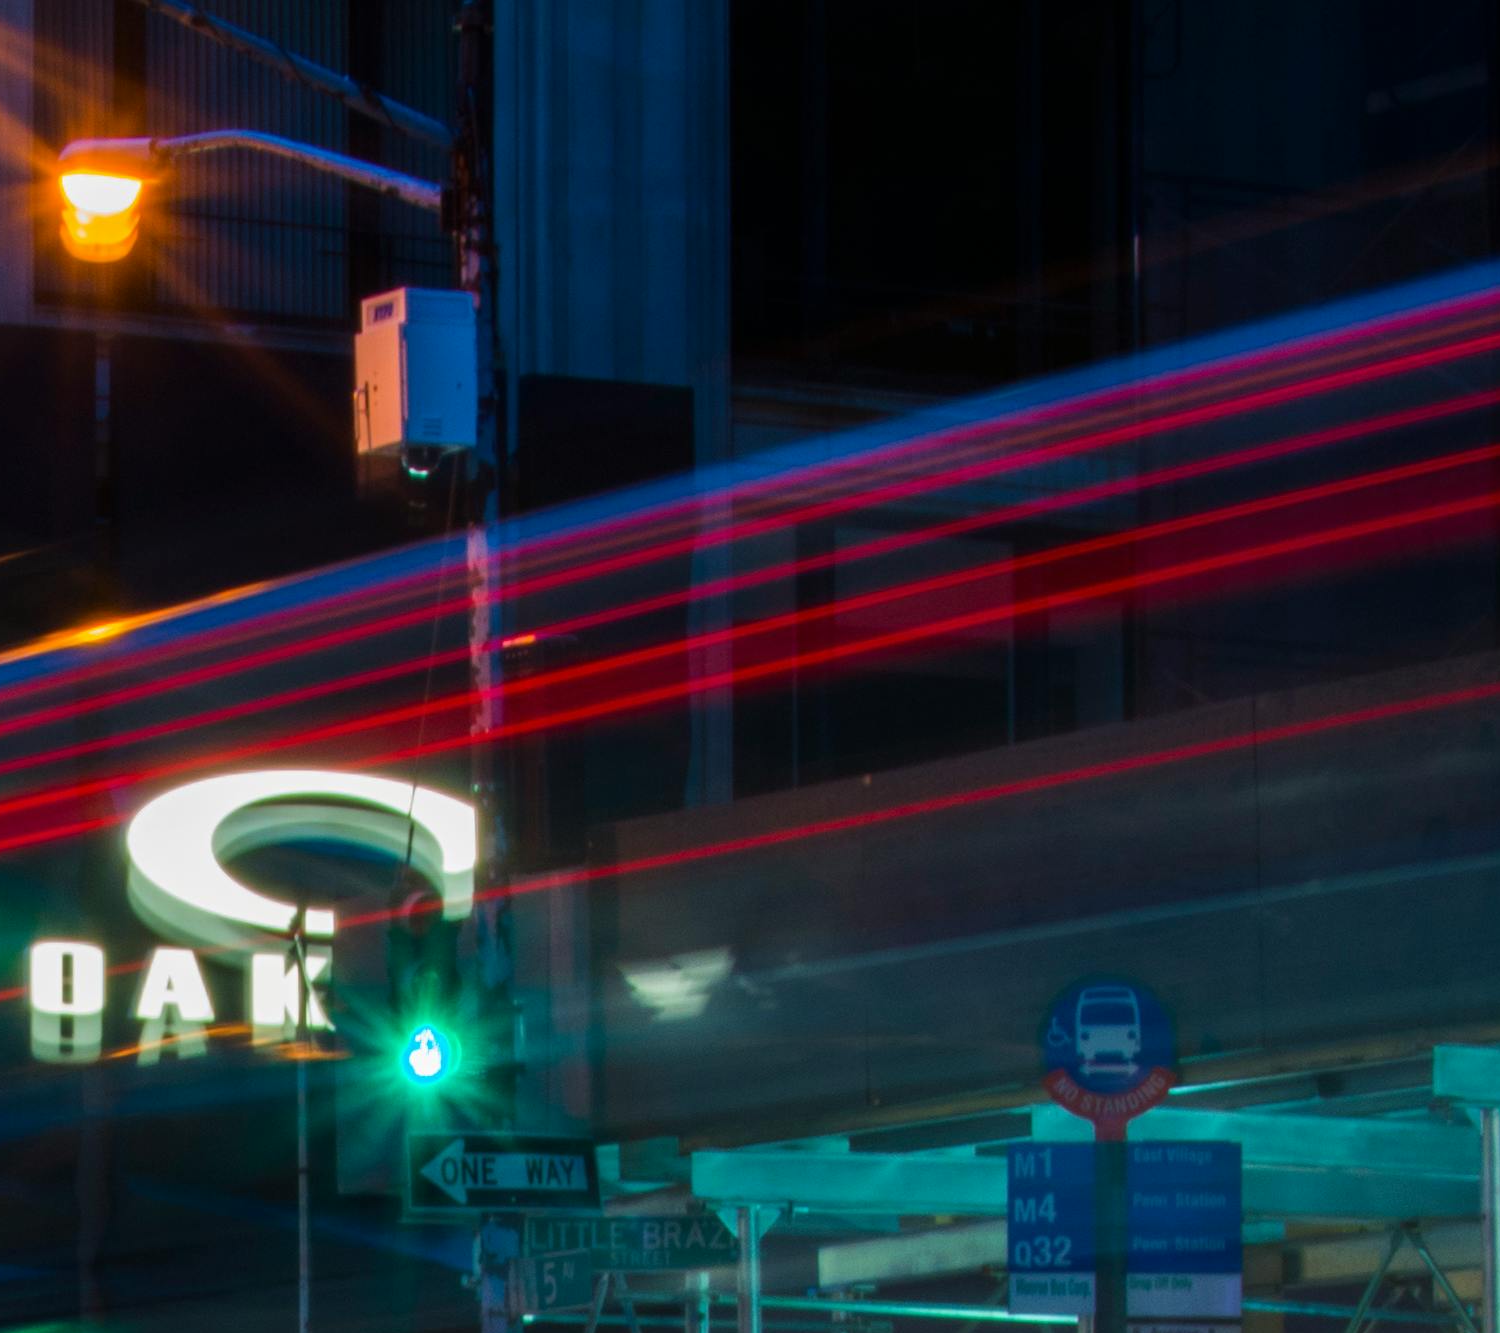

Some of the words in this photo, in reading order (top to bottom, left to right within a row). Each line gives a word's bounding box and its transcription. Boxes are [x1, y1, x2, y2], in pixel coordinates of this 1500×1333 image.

[1054, 1076, 1079, 1102] NO
[1080, 1072, 1166, 1114] STANDING
[440, 1156, 499, 1186] ONE
[524, 1157, 575, 1185] WAY
[1014, 1147, 1053, 1179] M1
[1014, 1193, 1057, 1224] M4
[530, 1219, 625, 1251] LITTLE
[642, 1219, 738, 1250] BRAZ
[542, 1261, 557, 1306] 5
